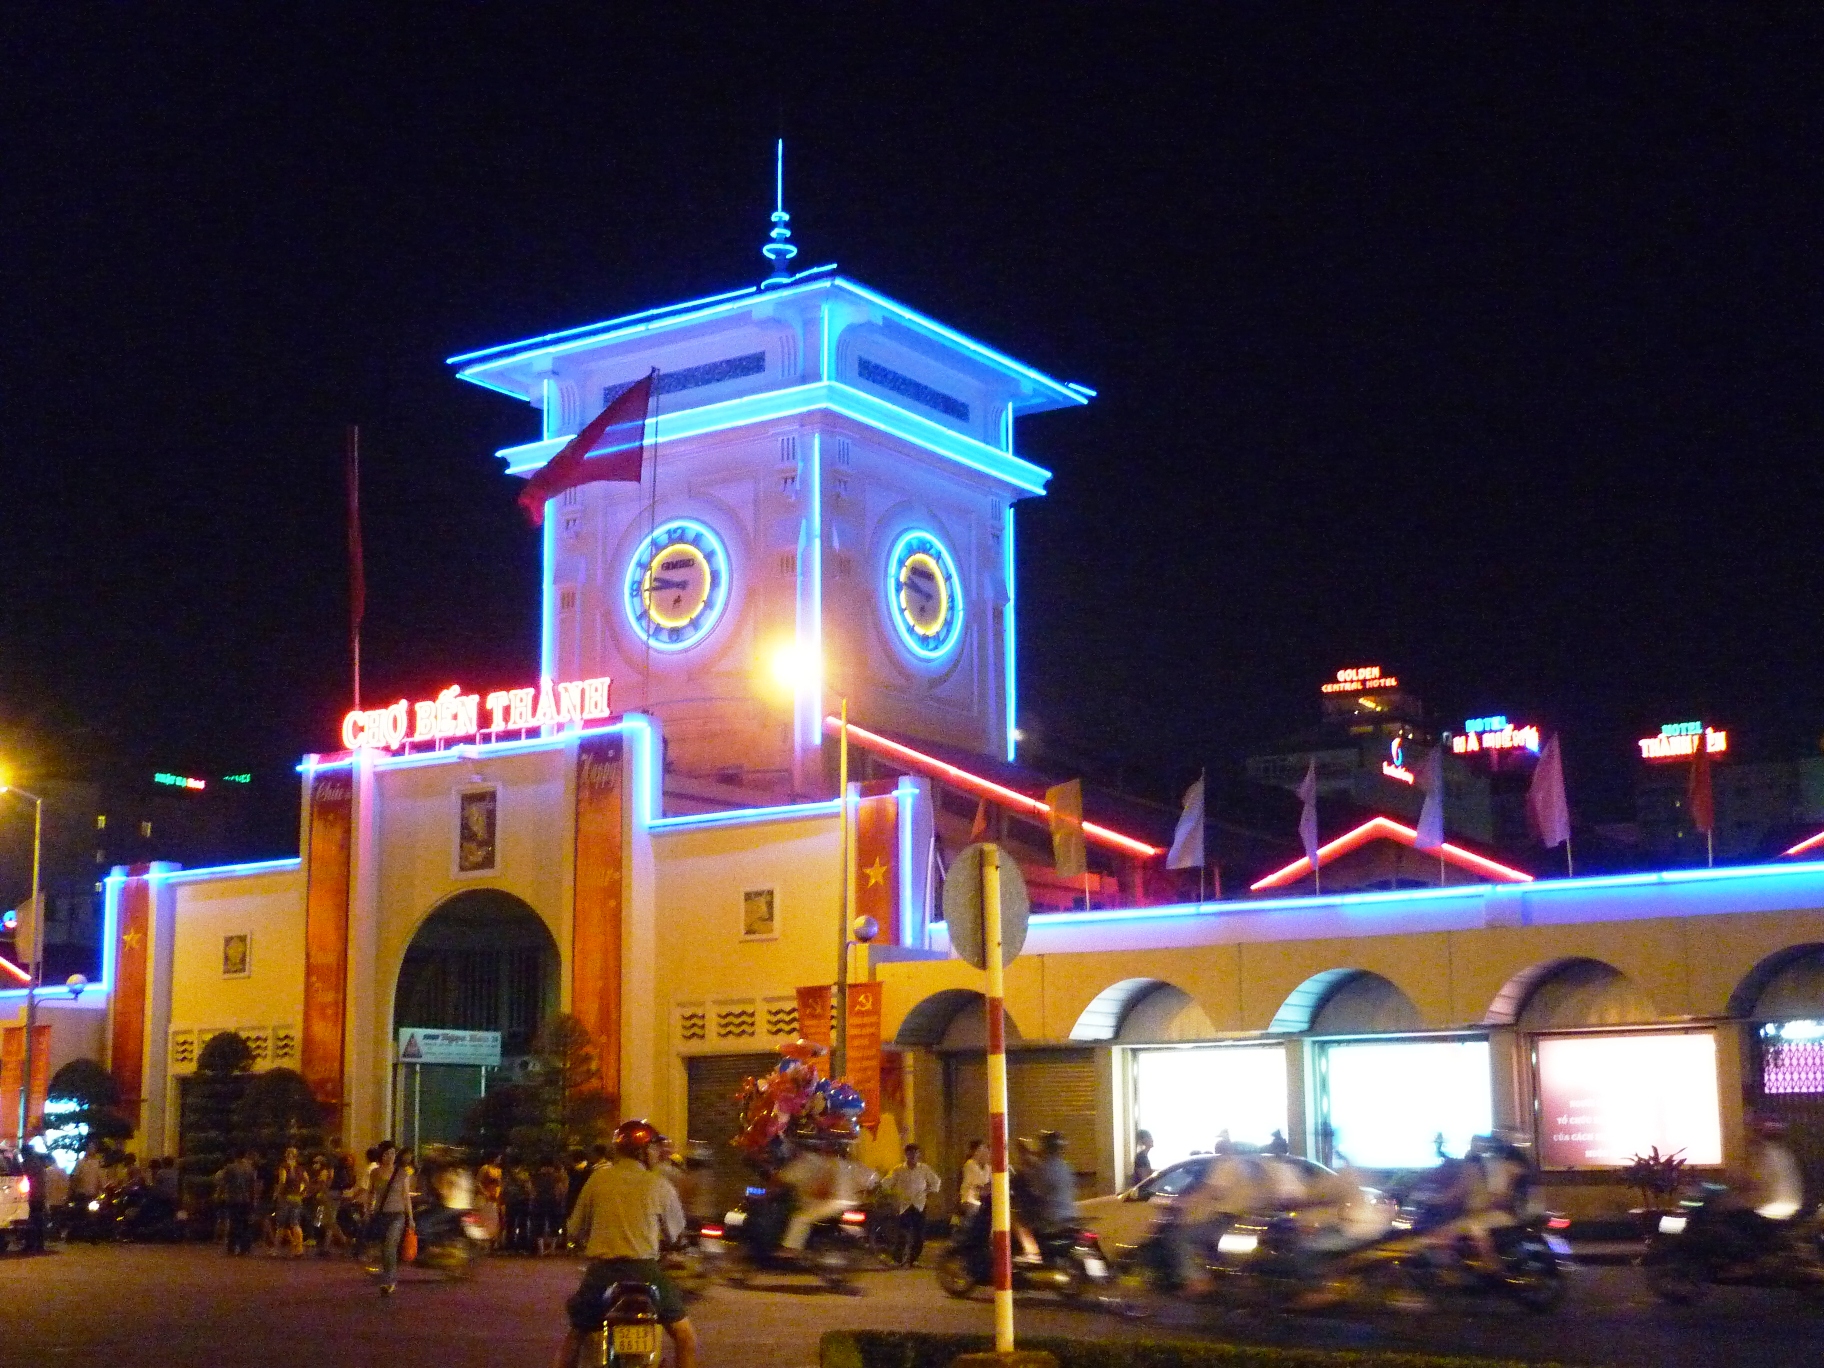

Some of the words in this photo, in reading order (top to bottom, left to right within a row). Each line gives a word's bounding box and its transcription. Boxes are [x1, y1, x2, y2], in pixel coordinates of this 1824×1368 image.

[1336, 666, 1380, 682] GOLDEN
[1321, 681, 1363, 693] CENTRAL
[1366, 677, 1398, 689] HOTEL
[342, 698, 408, 750] CHỢ
[413, 684, 480, 741] BẾN
[1465, 715, 1506, 732] HOTEL
[1661, 721, 1702, 737] HOTEL
